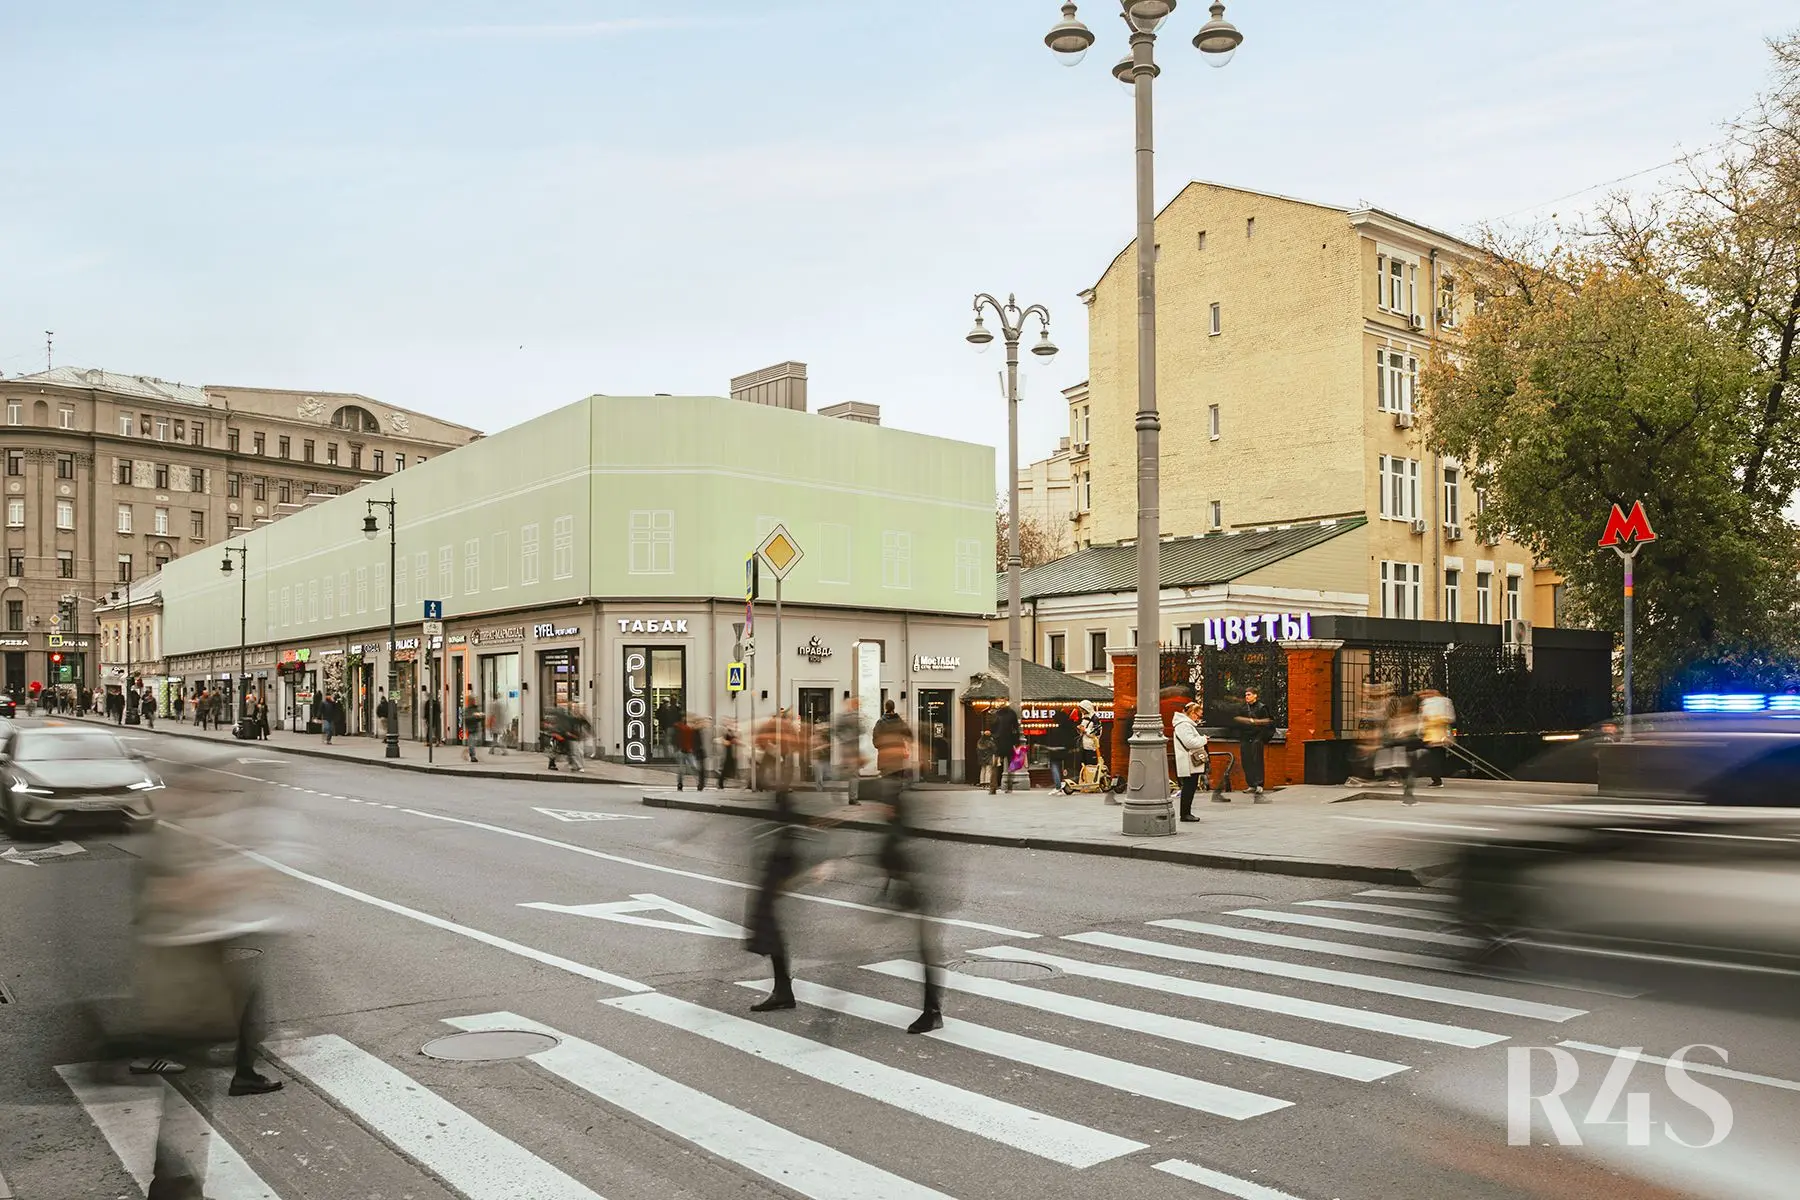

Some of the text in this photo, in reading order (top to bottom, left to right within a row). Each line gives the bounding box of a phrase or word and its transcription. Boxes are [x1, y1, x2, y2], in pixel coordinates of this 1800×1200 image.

[534, 623, 554, 638] EYFEL
[617, 619, 689, 633] ТАБАК
[1204, 612, 1311, 651] ЦВЕТЫ
[797, 646, 833, 657] ПРАВДА
[1021, 709, 1057, 719] ОНЕР
